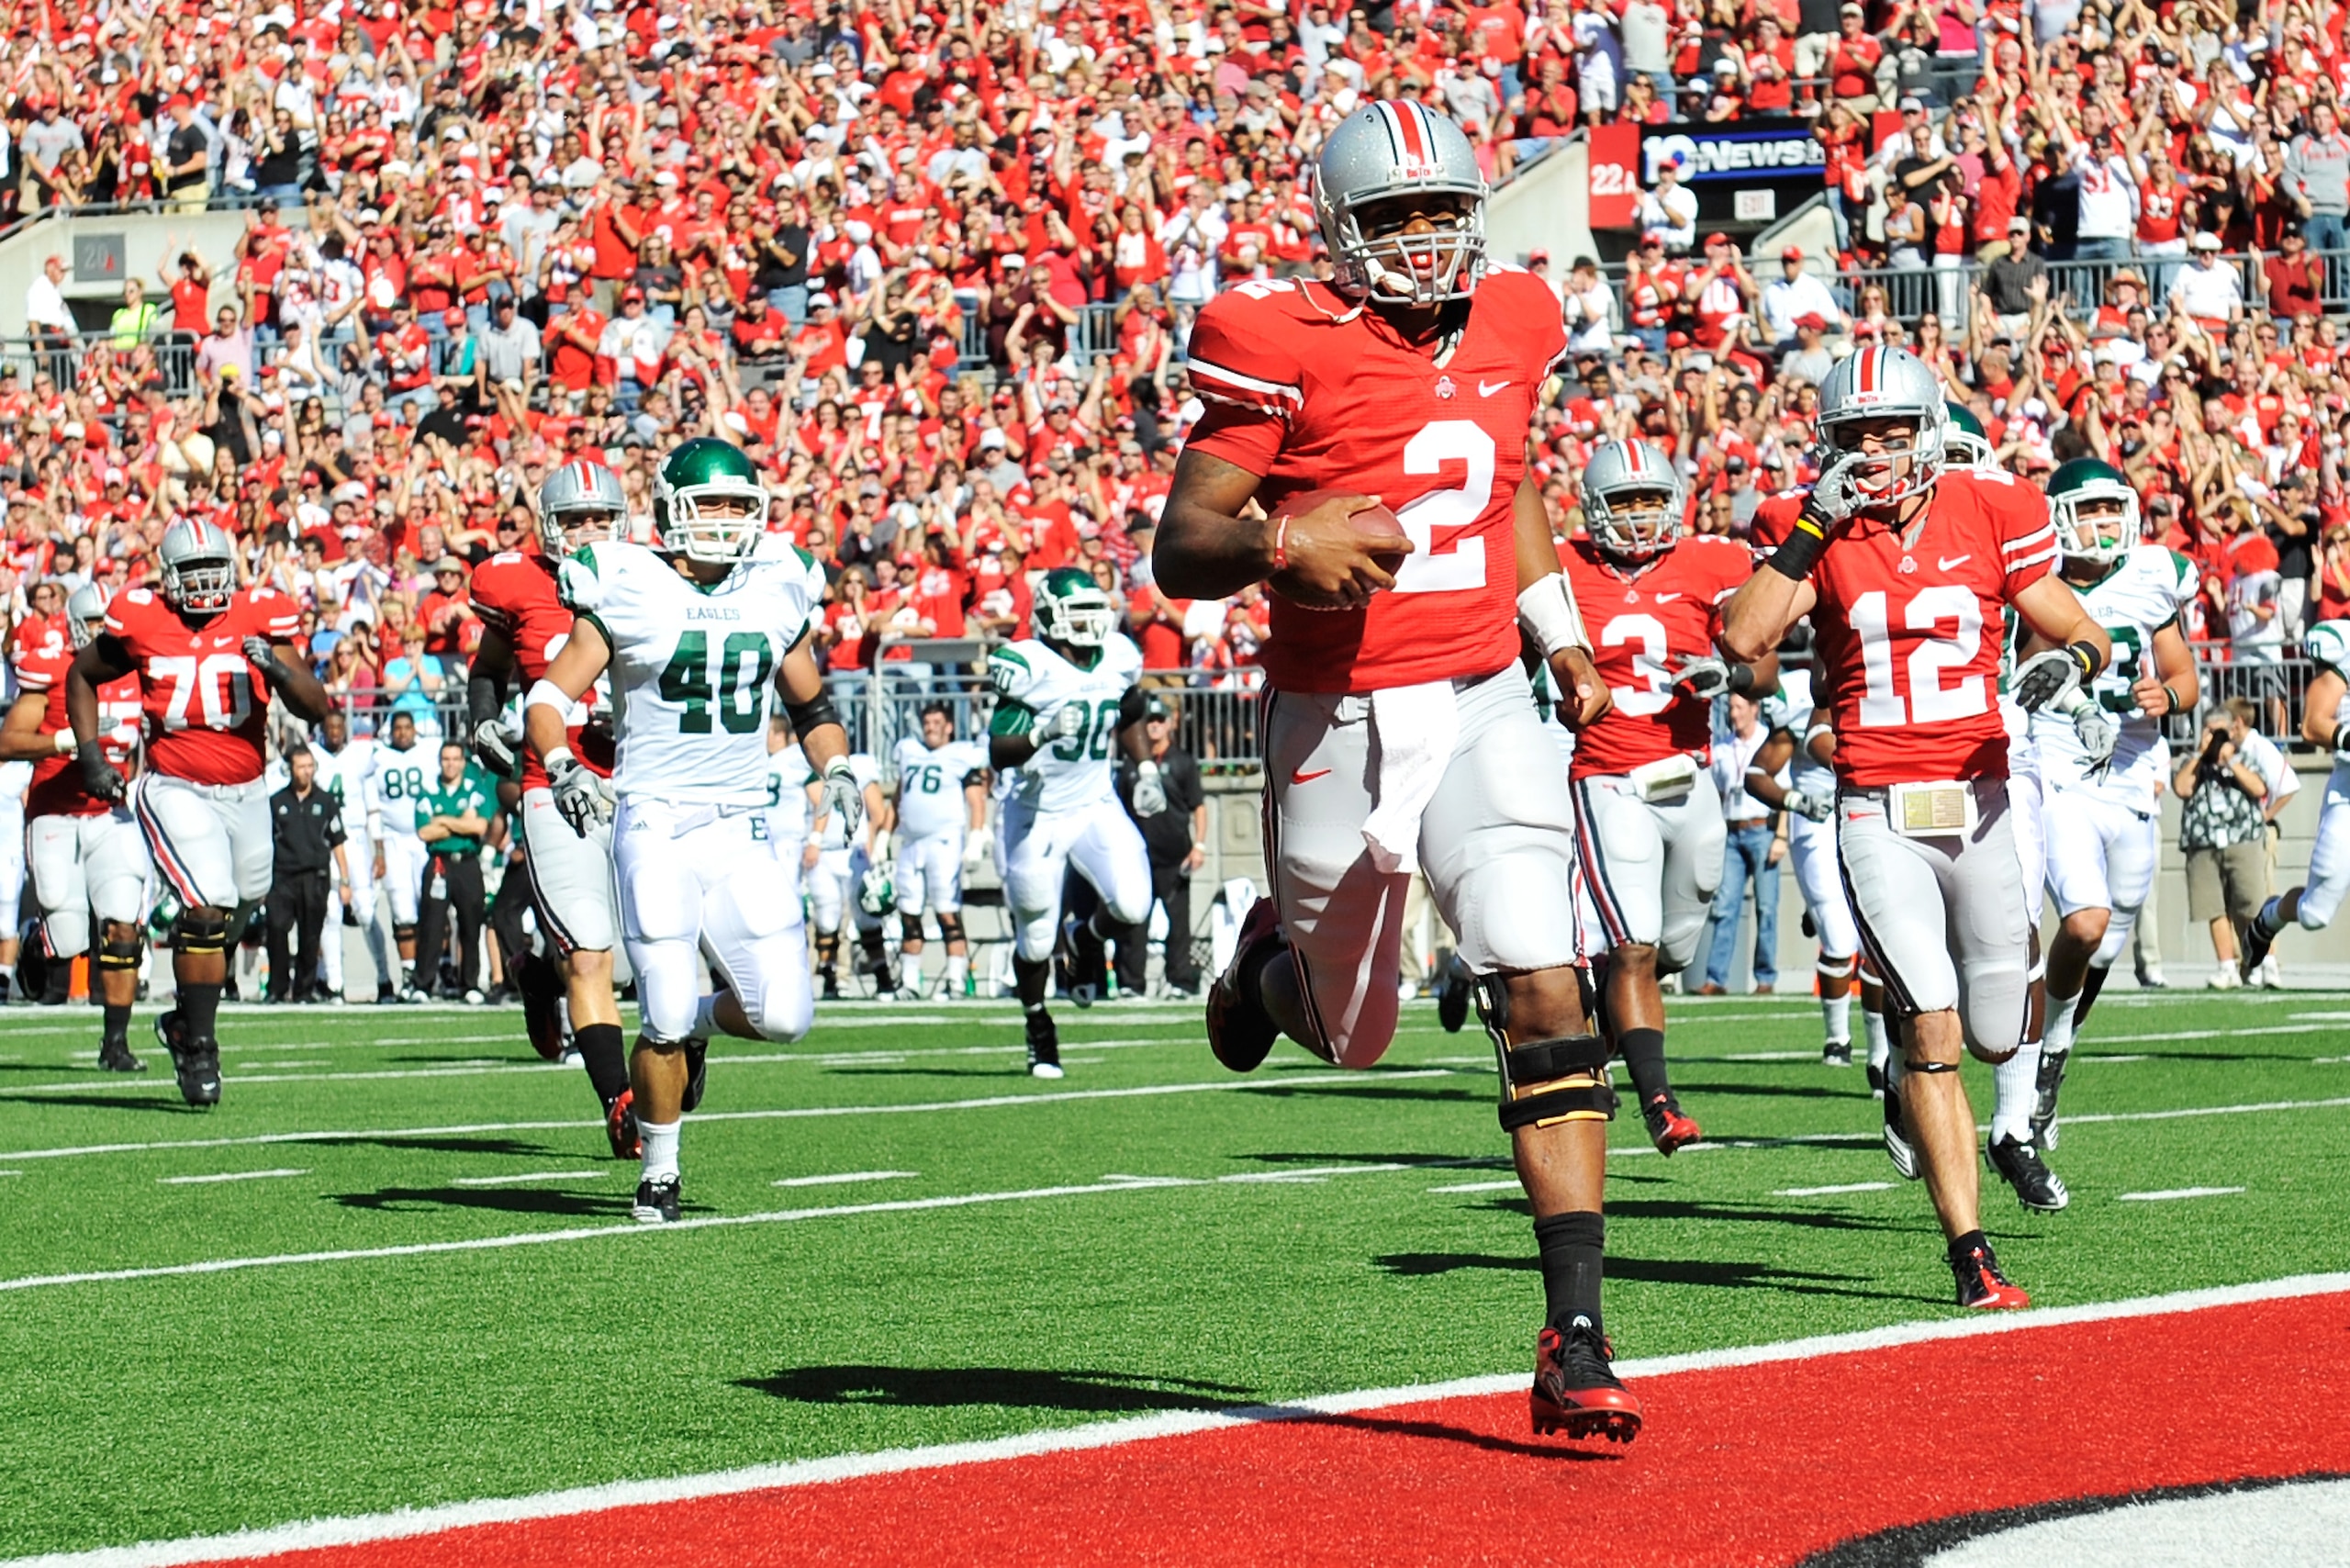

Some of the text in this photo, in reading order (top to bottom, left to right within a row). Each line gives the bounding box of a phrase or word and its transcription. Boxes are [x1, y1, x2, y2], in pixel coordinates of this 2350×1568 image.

[1591, 162, 1636, 196] 22A
[1396, 420, 1496, 594] 2
[687, 607, 741, 621] EAGLES
[658, 630, 773, 734] 40
[1601, 613, 1673, 718] 3
[1848, 585, 1989, 726] 12
[149, 653, 252, 733] 70
[385, 767, 423, 800] 88
[903, 765, 943, 795] 76
[749, 816, 768, 841] E
